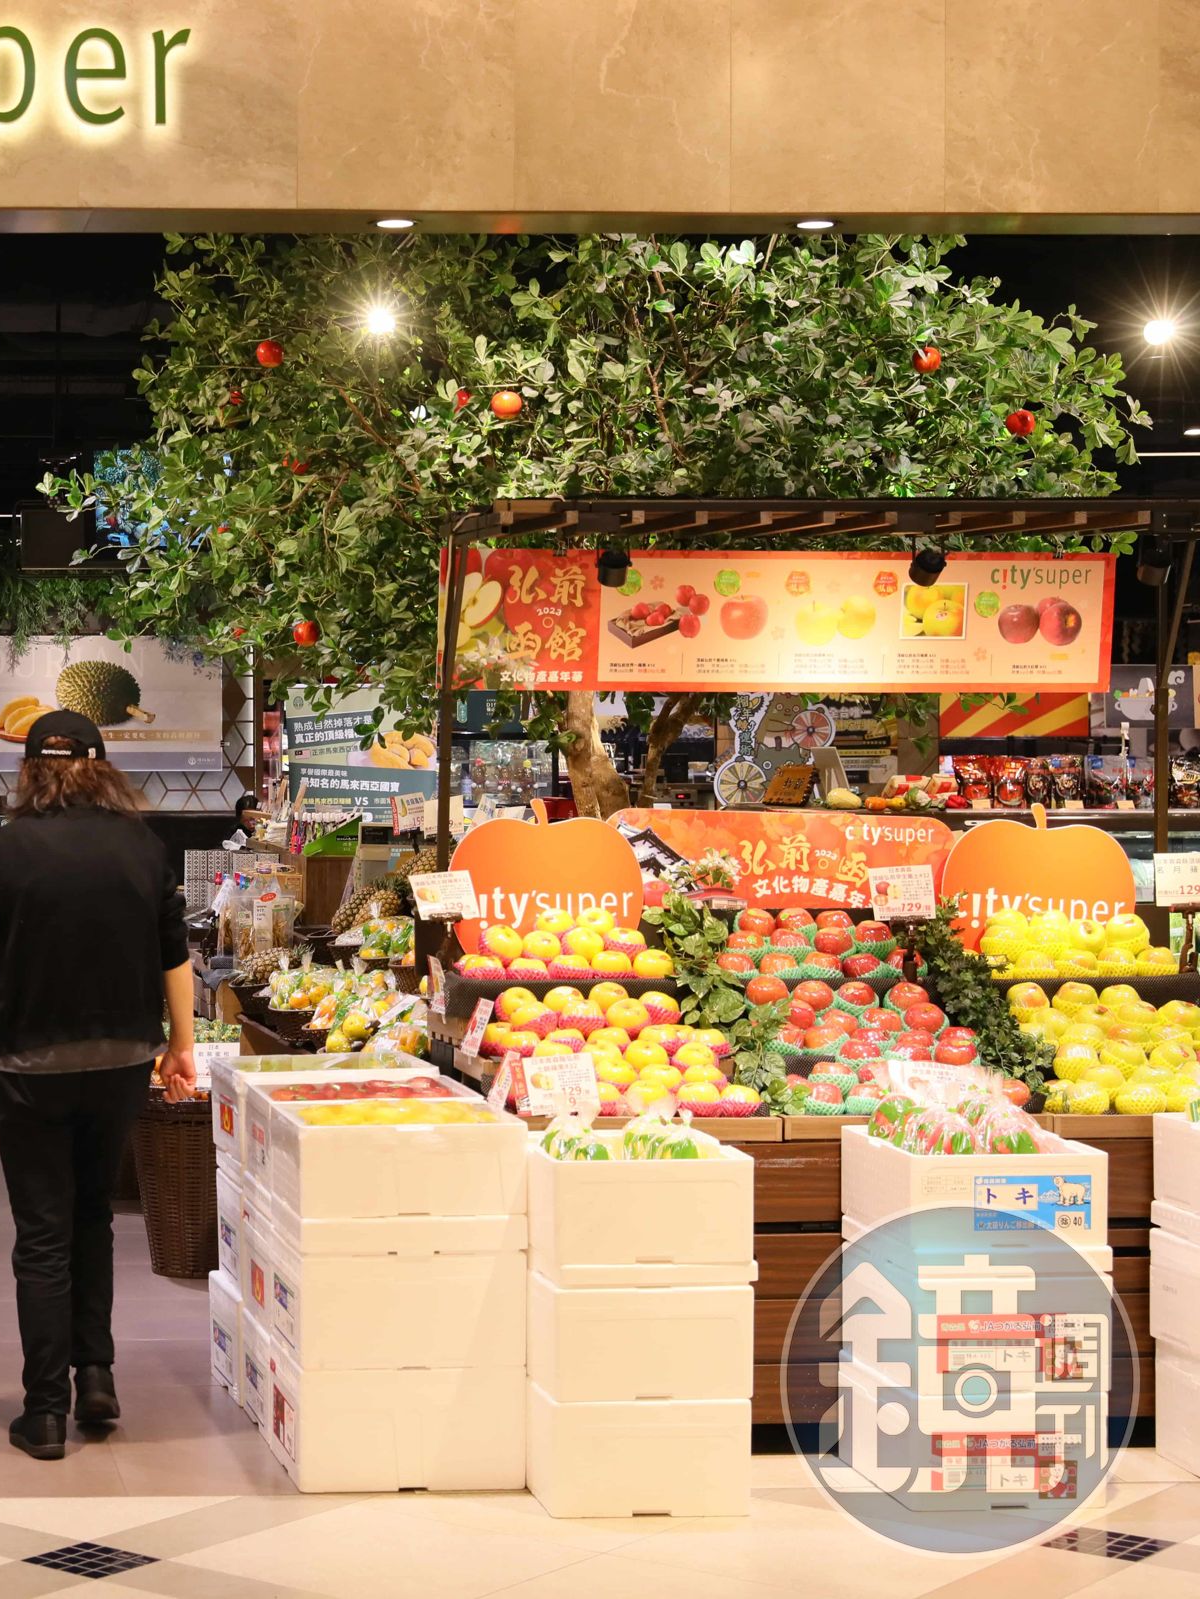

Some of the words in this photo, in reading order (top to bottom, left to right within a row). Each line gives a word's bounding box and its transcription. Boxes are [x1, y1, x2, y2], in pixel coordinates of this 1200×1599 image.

[507, 564, 588, 608] 弘前
[536, 607, 562, 617] 2023
[499, 669, 584, 684] 文化物產嘉年華
[355, 796, 369, 806] VS
[738, 833, 811, 876] 弘前
[814, 848, 838, 861] 2023
[752, 875, 872, 908] 文化物產嘉年
[1072, 1216, 1083, 1227] 40
